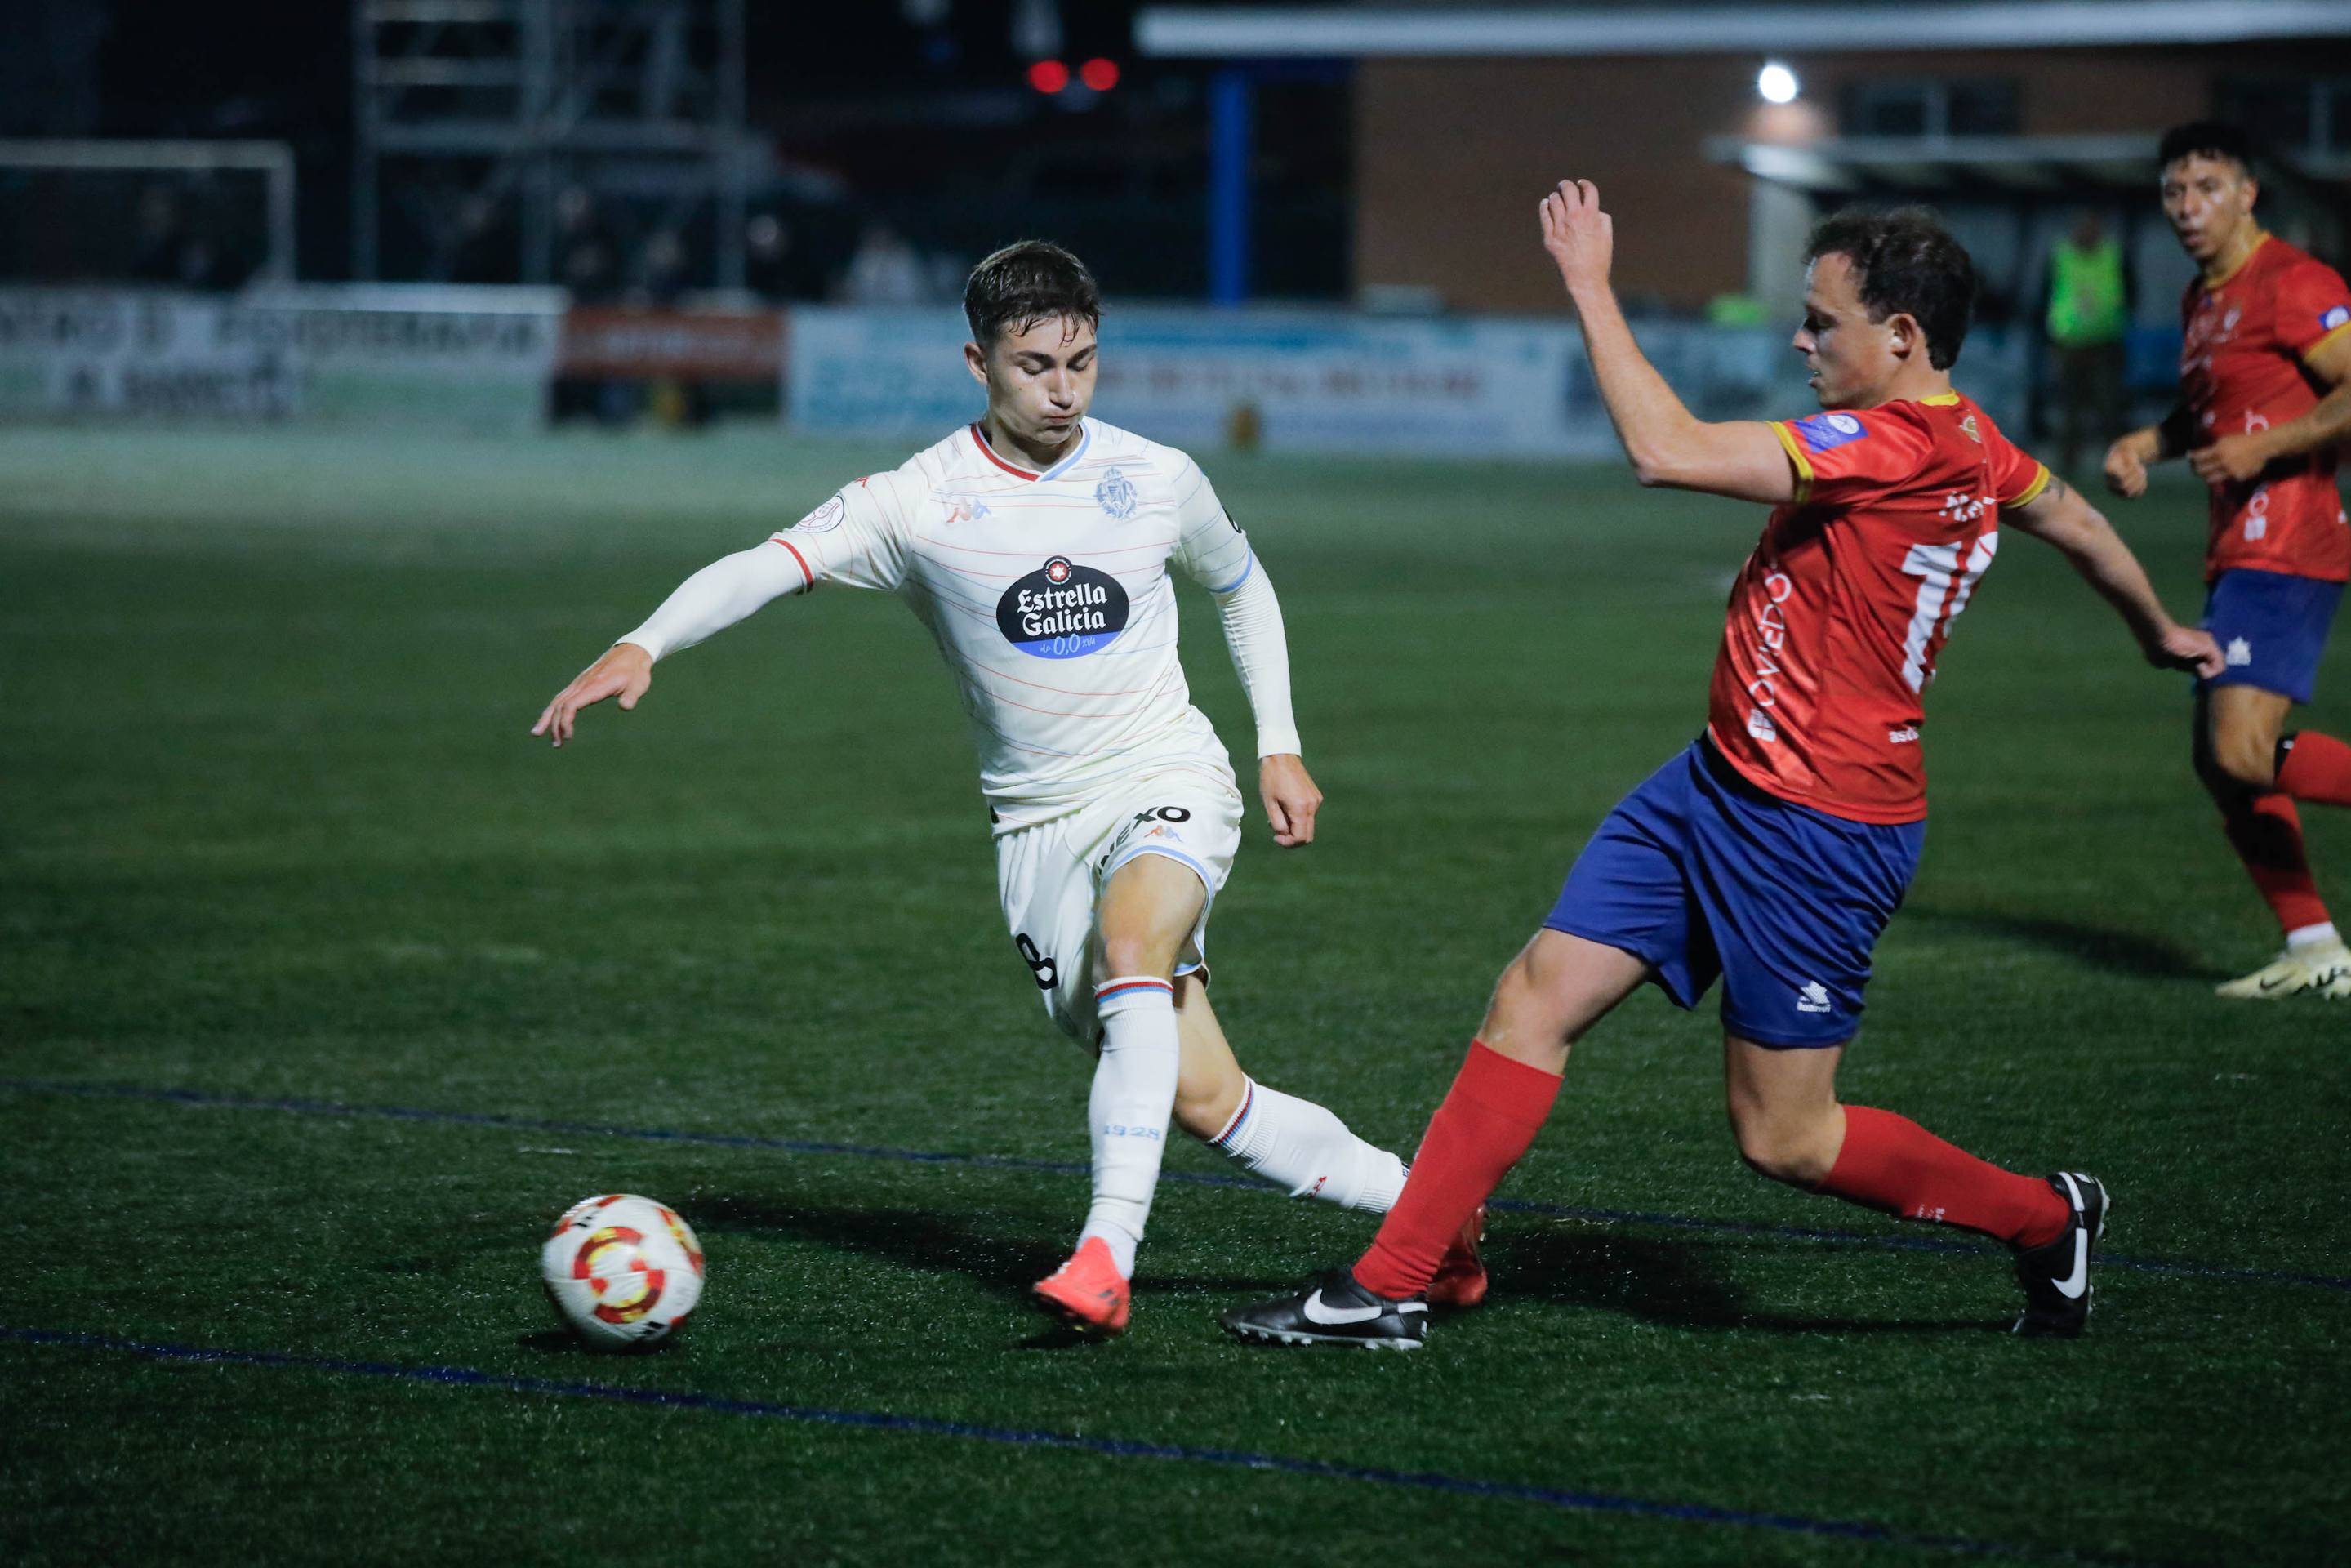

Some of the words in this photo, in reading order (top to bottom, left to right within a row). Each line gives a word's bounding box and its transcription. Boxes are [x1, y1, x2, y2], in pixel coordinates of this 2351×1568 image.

[1017, 582, 1108, 613] Estrella
[1022, 607, 1106, 636] Galicia
[1053, 633, 1080, 656] 0,0
[1748, 573, 1792, 707] OVIEDO
[1016, 933, 1058, 990] 8
